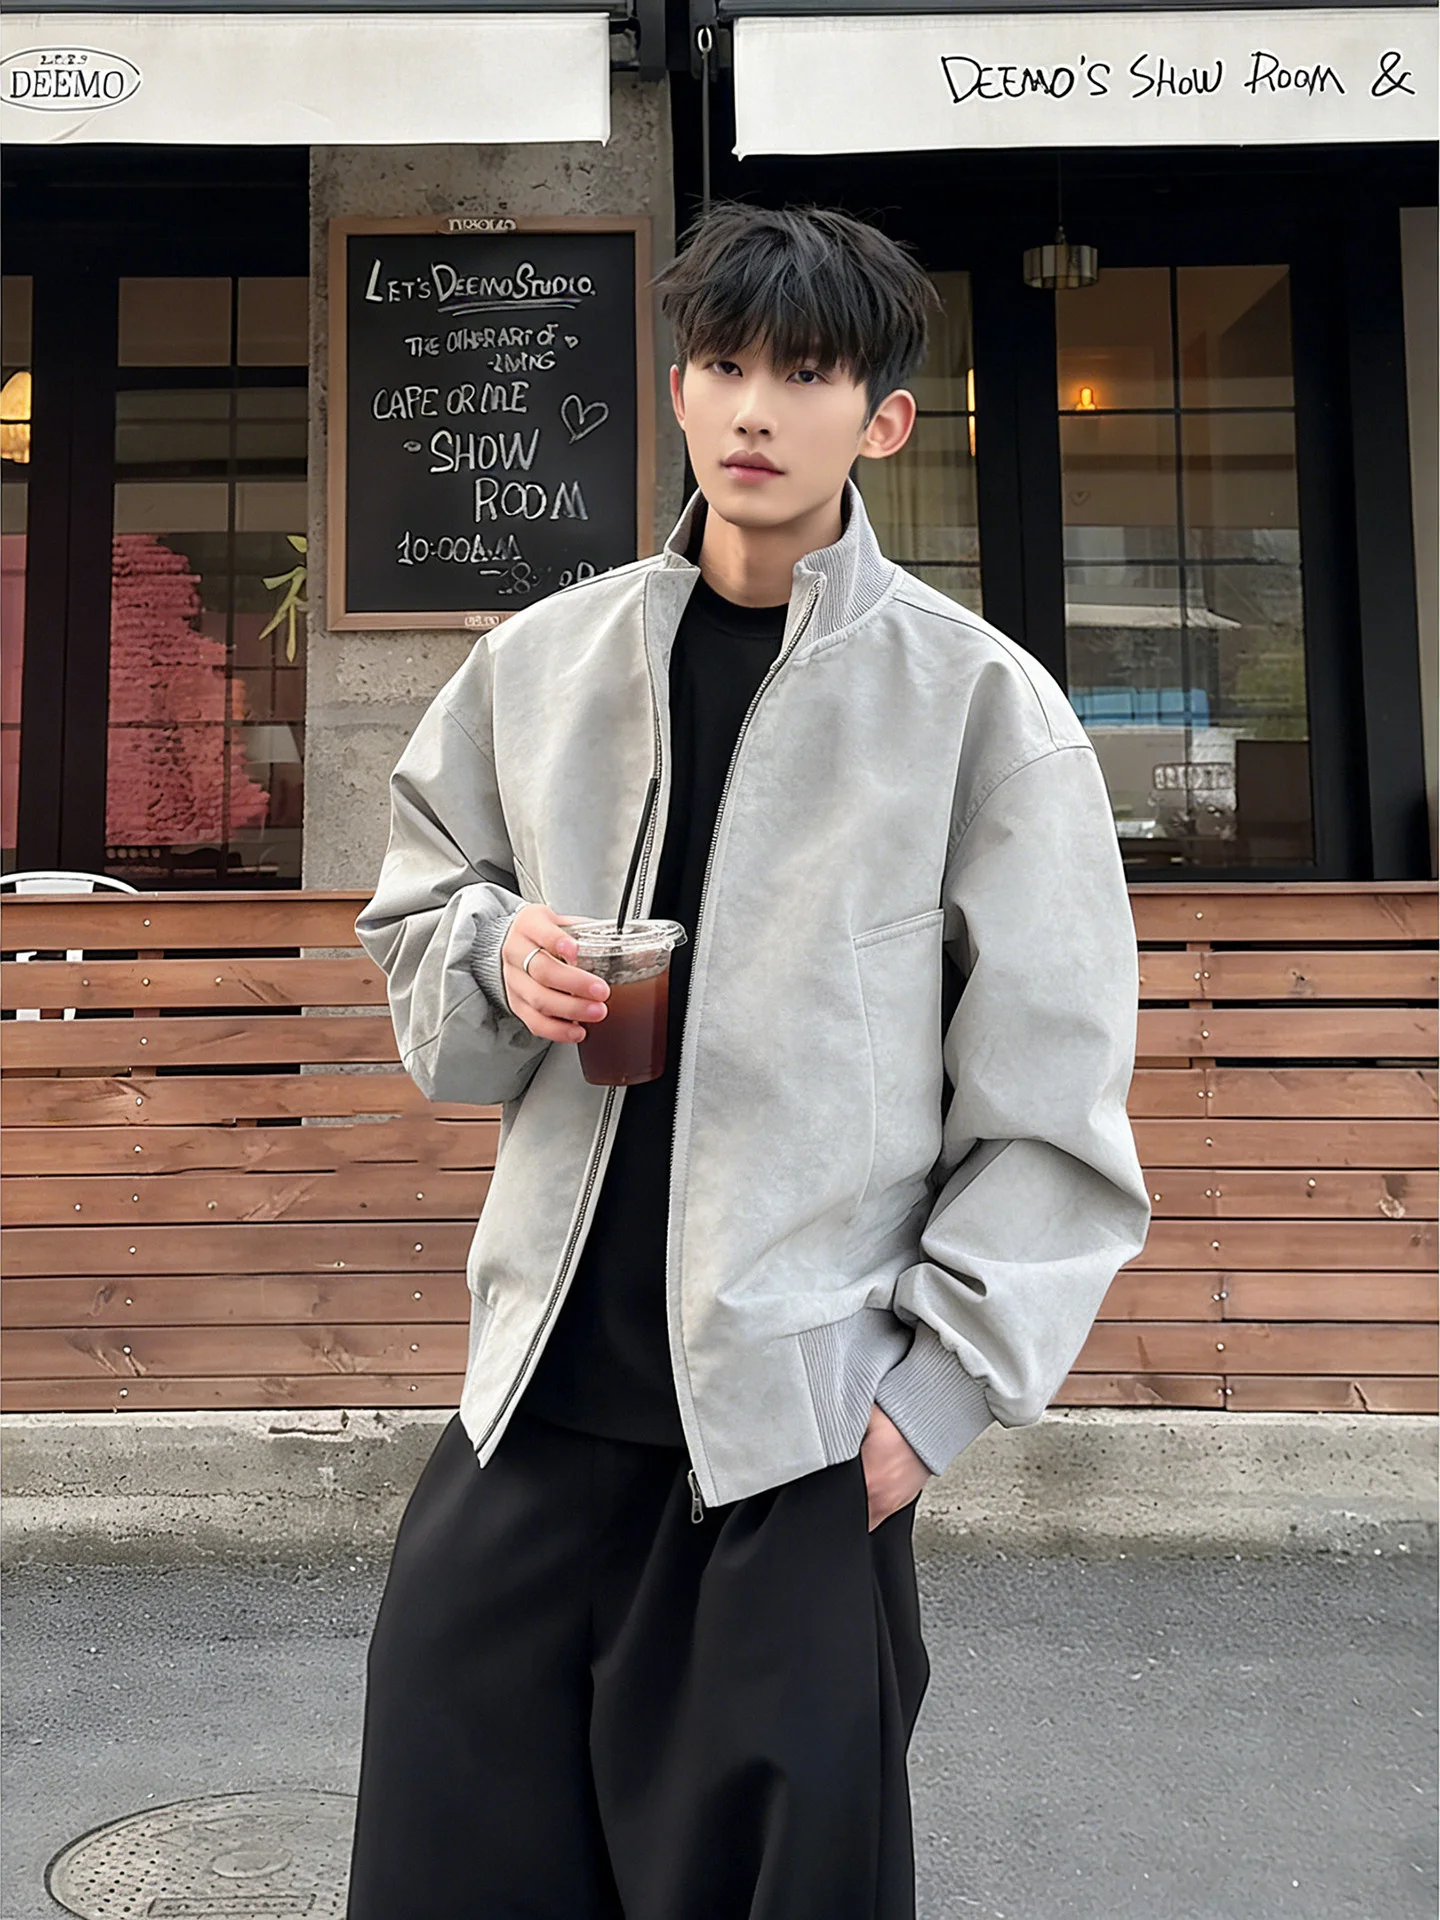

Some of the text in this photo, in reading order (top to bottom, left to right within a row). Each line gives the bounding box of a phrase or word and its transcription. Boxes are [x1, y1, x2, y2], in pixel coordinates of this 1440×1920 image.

[9, 69, 125, 99] DEEMO
[940, 51, 1416, 104] DEEMO'S SHOW ROOM &
[430, 428, 540, 473] SHOW
[475, 476, 589, 523] ROOM
